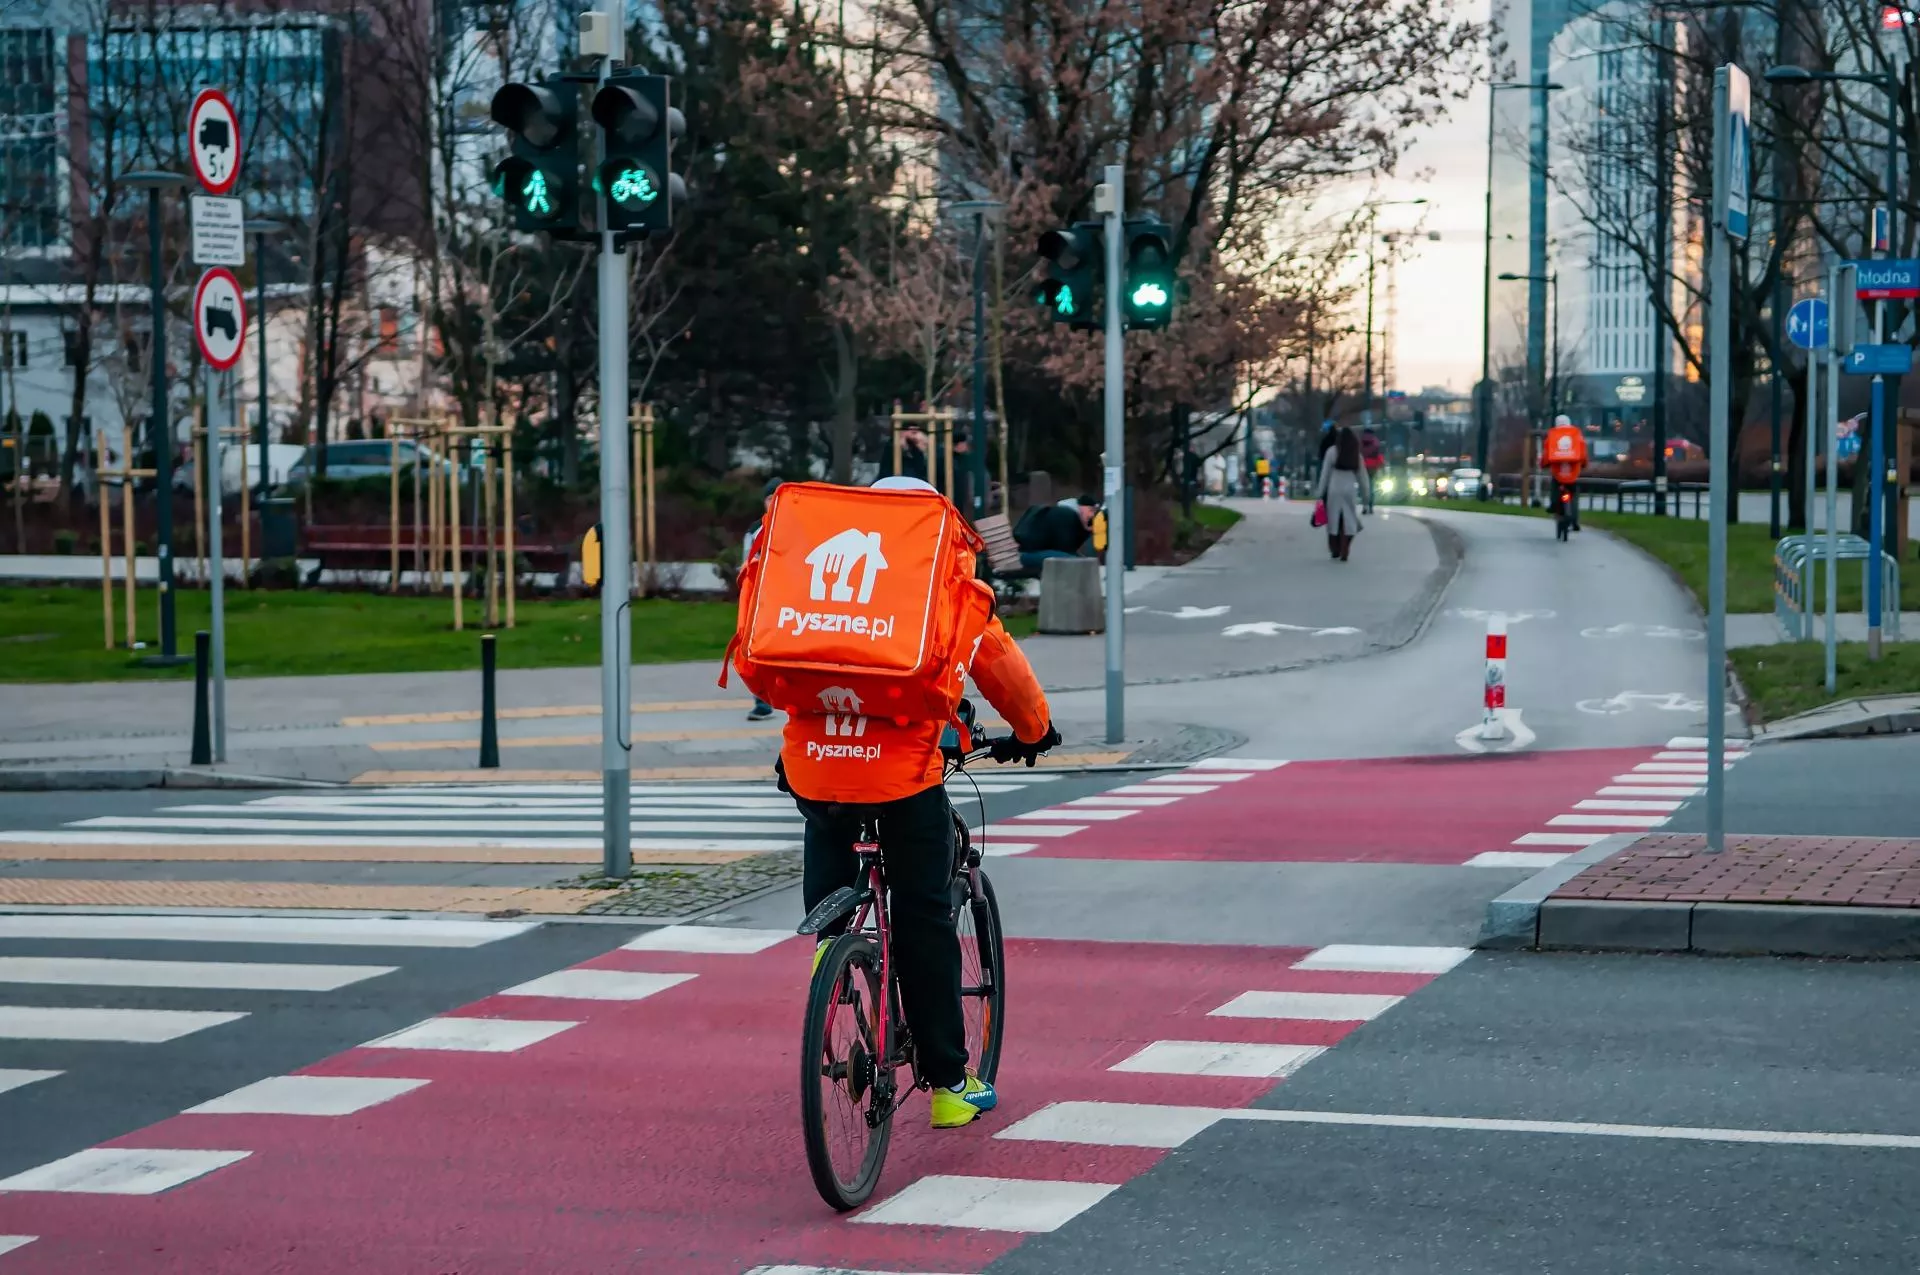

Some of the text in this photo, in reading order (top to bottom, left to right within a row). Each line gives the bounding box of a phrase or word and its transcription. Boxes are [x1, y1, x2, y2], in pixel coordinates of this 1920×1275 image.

[209, 153, 217, 178] 5
[1858, 268, 1911, 284] hłodna
[1855, 352, 1865, 366] P
[778, 606, 895, 641] Pyszne.pl
[807, 741, 881, 763] Pyszne.pl
